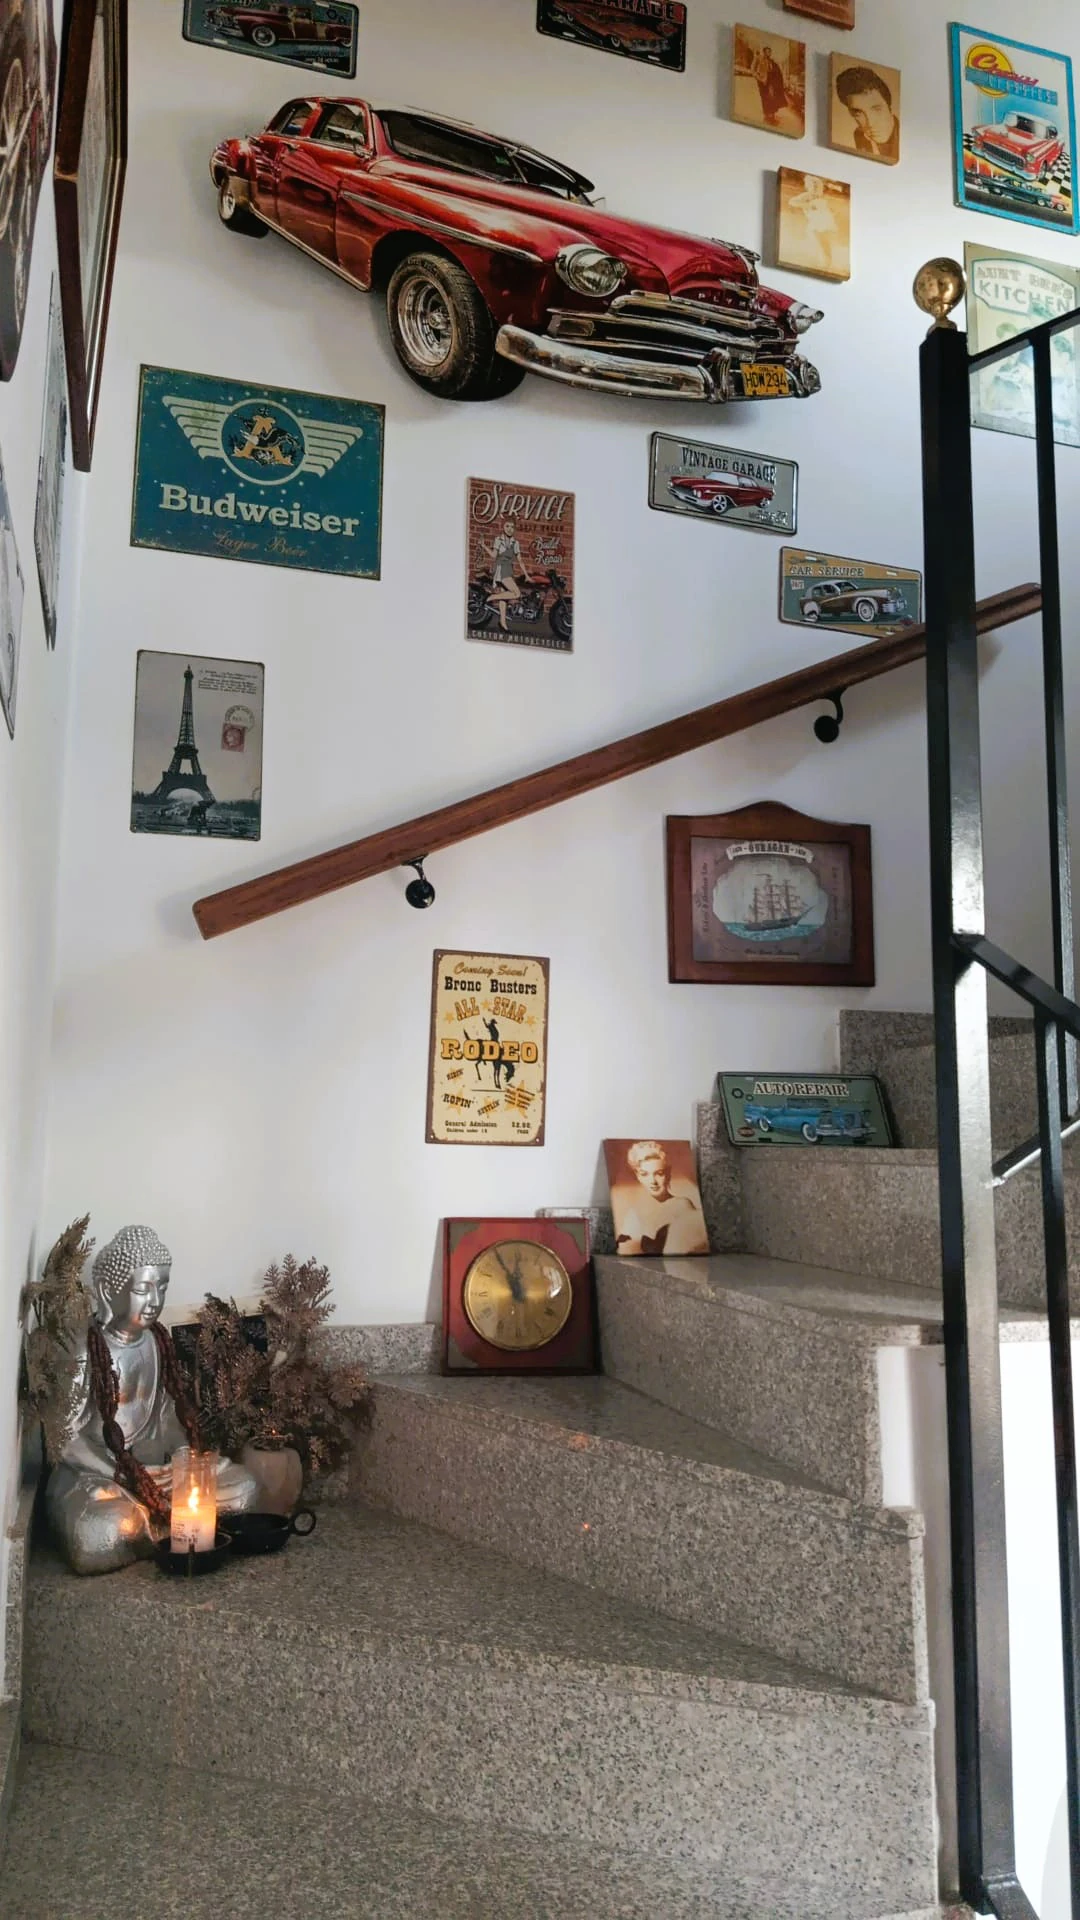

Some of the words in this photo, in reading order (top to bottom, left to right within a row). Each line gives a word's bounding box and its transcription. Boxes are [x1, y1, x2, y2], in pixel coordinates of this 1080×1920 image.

[682, 447, 729, 471] VINTAGE
[732, 460, 776, 485] GARAGE
[159, 483, 360, 537] Budweiser
[214, 529, 259, 554] Lager
[265, 535, 309, 557] Beer
[790, 566, 812, 576] CAR
[819, 566, 865, 577] SERVICE
[471, 630, 504, 642] CUSTOM
[453, 962, 494, 978] Coming
[498, 965, 528, 977] Soon!
[444, 976, 482, 992] Bronc
[490, 978, 538, 995] Busters
[454, 996, 481, 1021] ALL
[491, 996, 527, 1024] STAR
[441, 1038, 538, 1063] RODEO
[754, 1081, 795, 1096] AUTO
[796, 1082, 849, 1097] REPAIR
